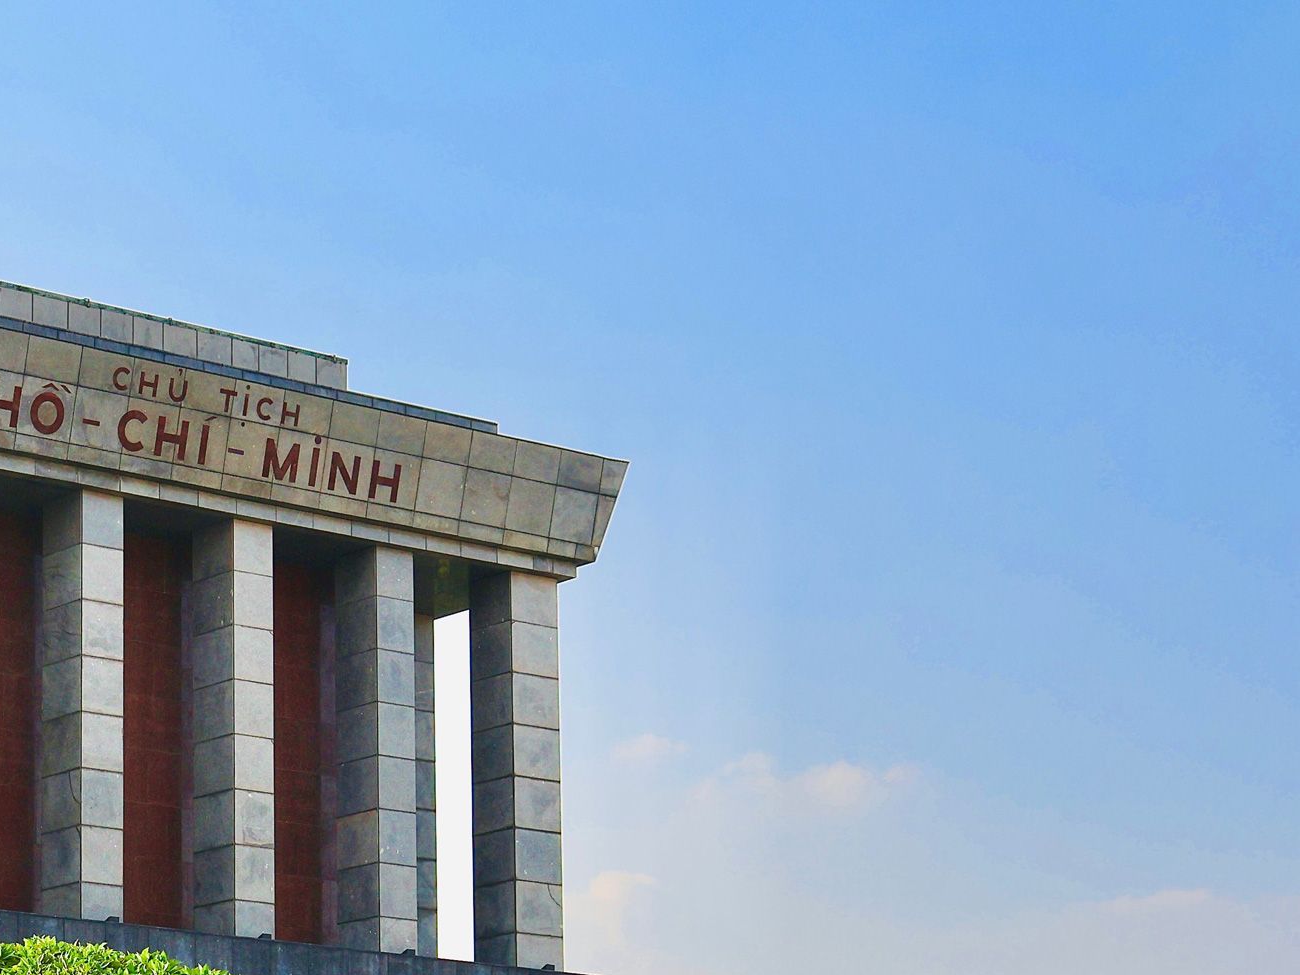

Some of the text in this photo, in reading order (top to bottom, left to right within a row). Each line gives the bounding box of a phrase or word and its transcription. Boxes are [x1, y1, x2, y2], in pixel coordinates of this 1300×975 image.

[112, 366, 300, 427] CHỦ TỊCH
[117, 409, 218, 465] CHÍ
[261, 435, 402, 503] MINH
